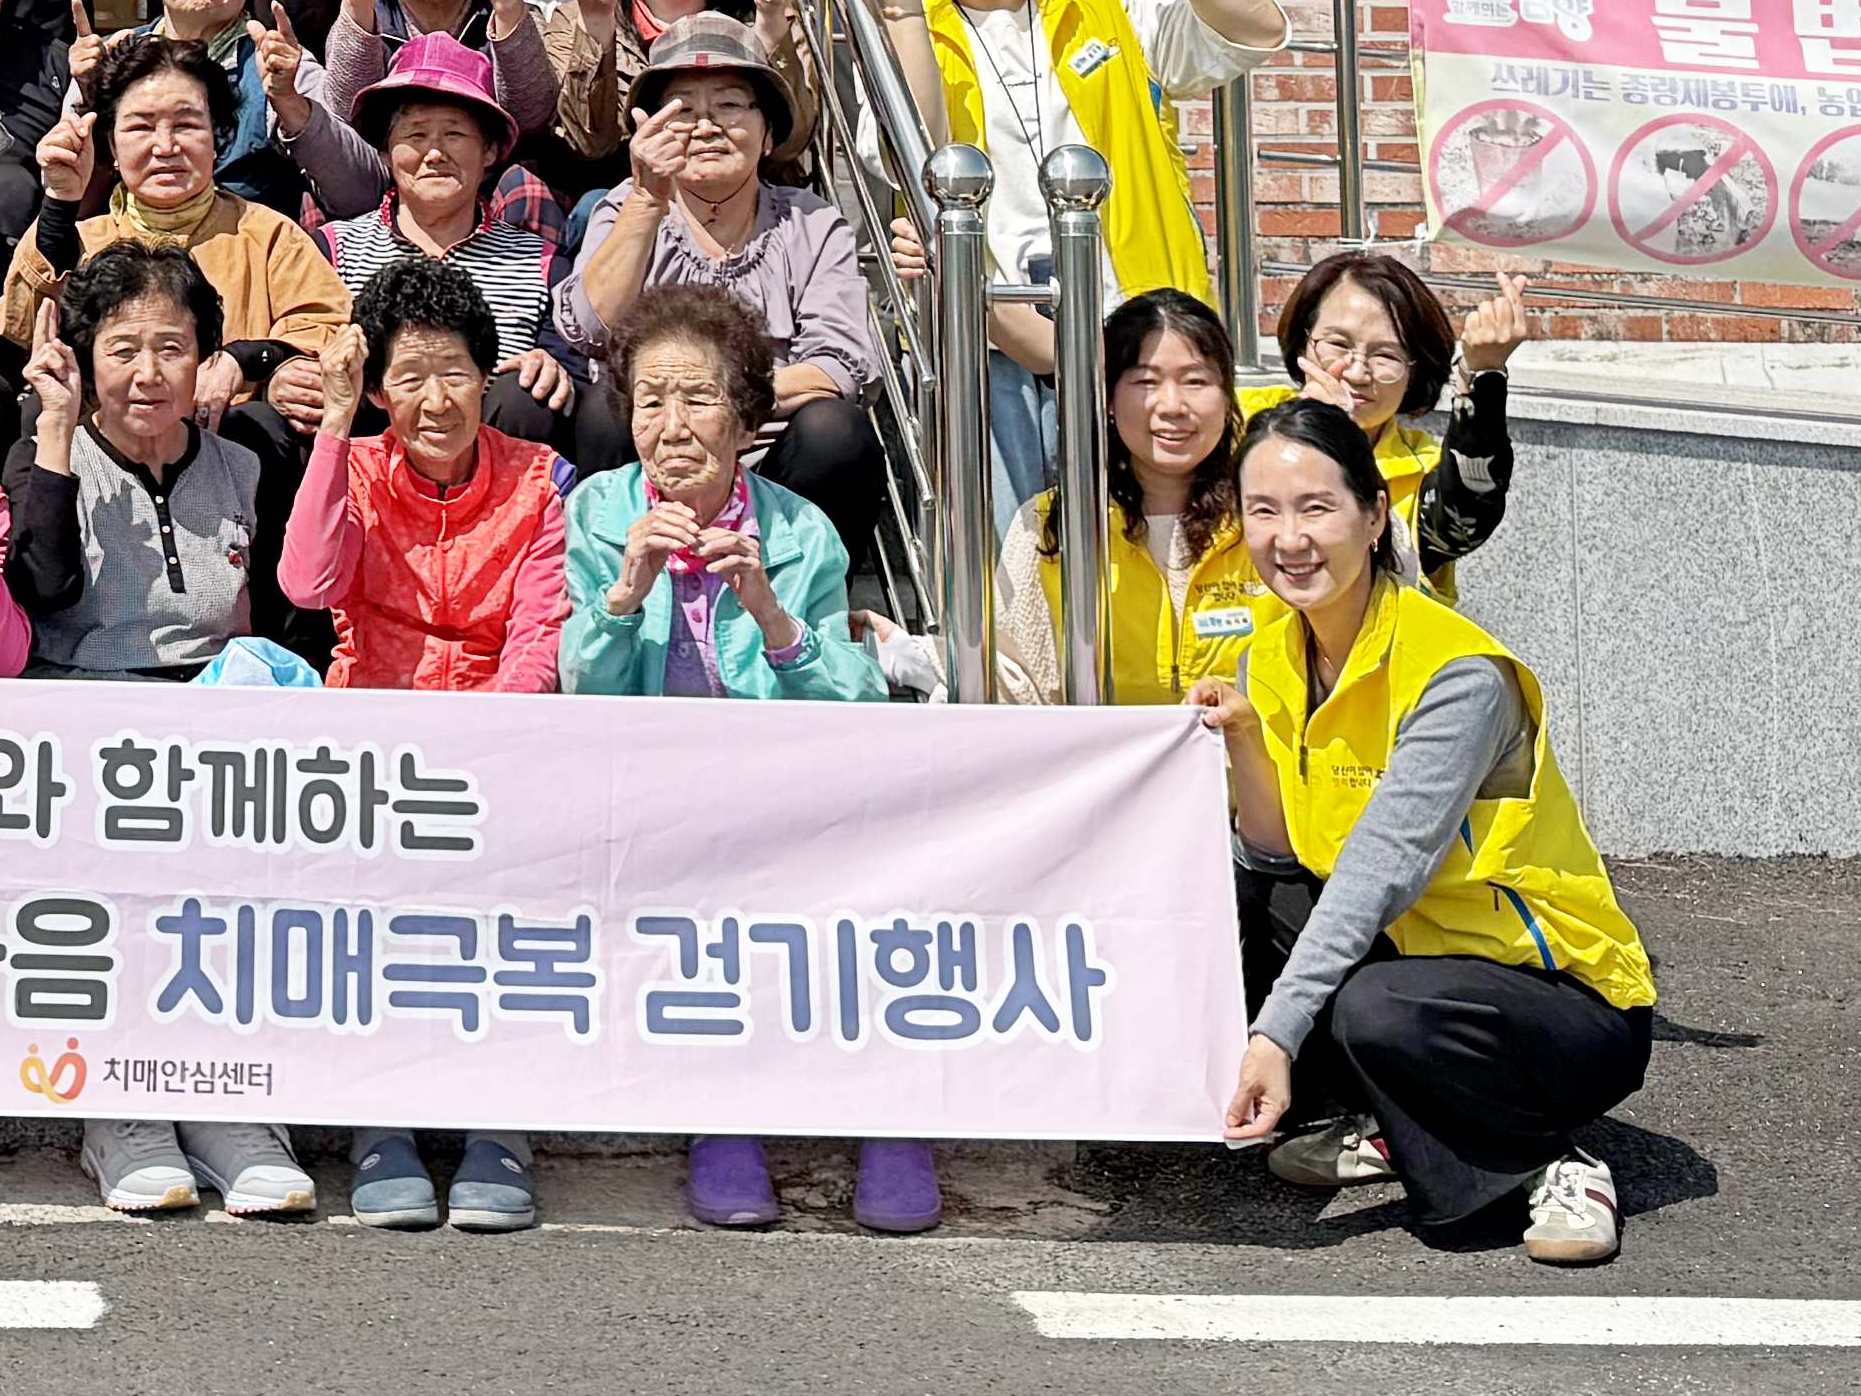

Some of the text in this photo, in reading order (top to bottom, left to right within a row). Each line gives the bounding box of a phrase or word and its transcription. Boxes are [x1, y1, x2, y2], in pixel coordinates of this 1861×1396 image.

[1491, 61, 1611, 101] 쓰레기는
[99, 738, 480, 852] 함께하는
[157, 897, 598, 1036] 치매극복
[635, 915, 1107, 1043] 걷기행사
[103, 1055, 274, 1097] 치매안심센터
